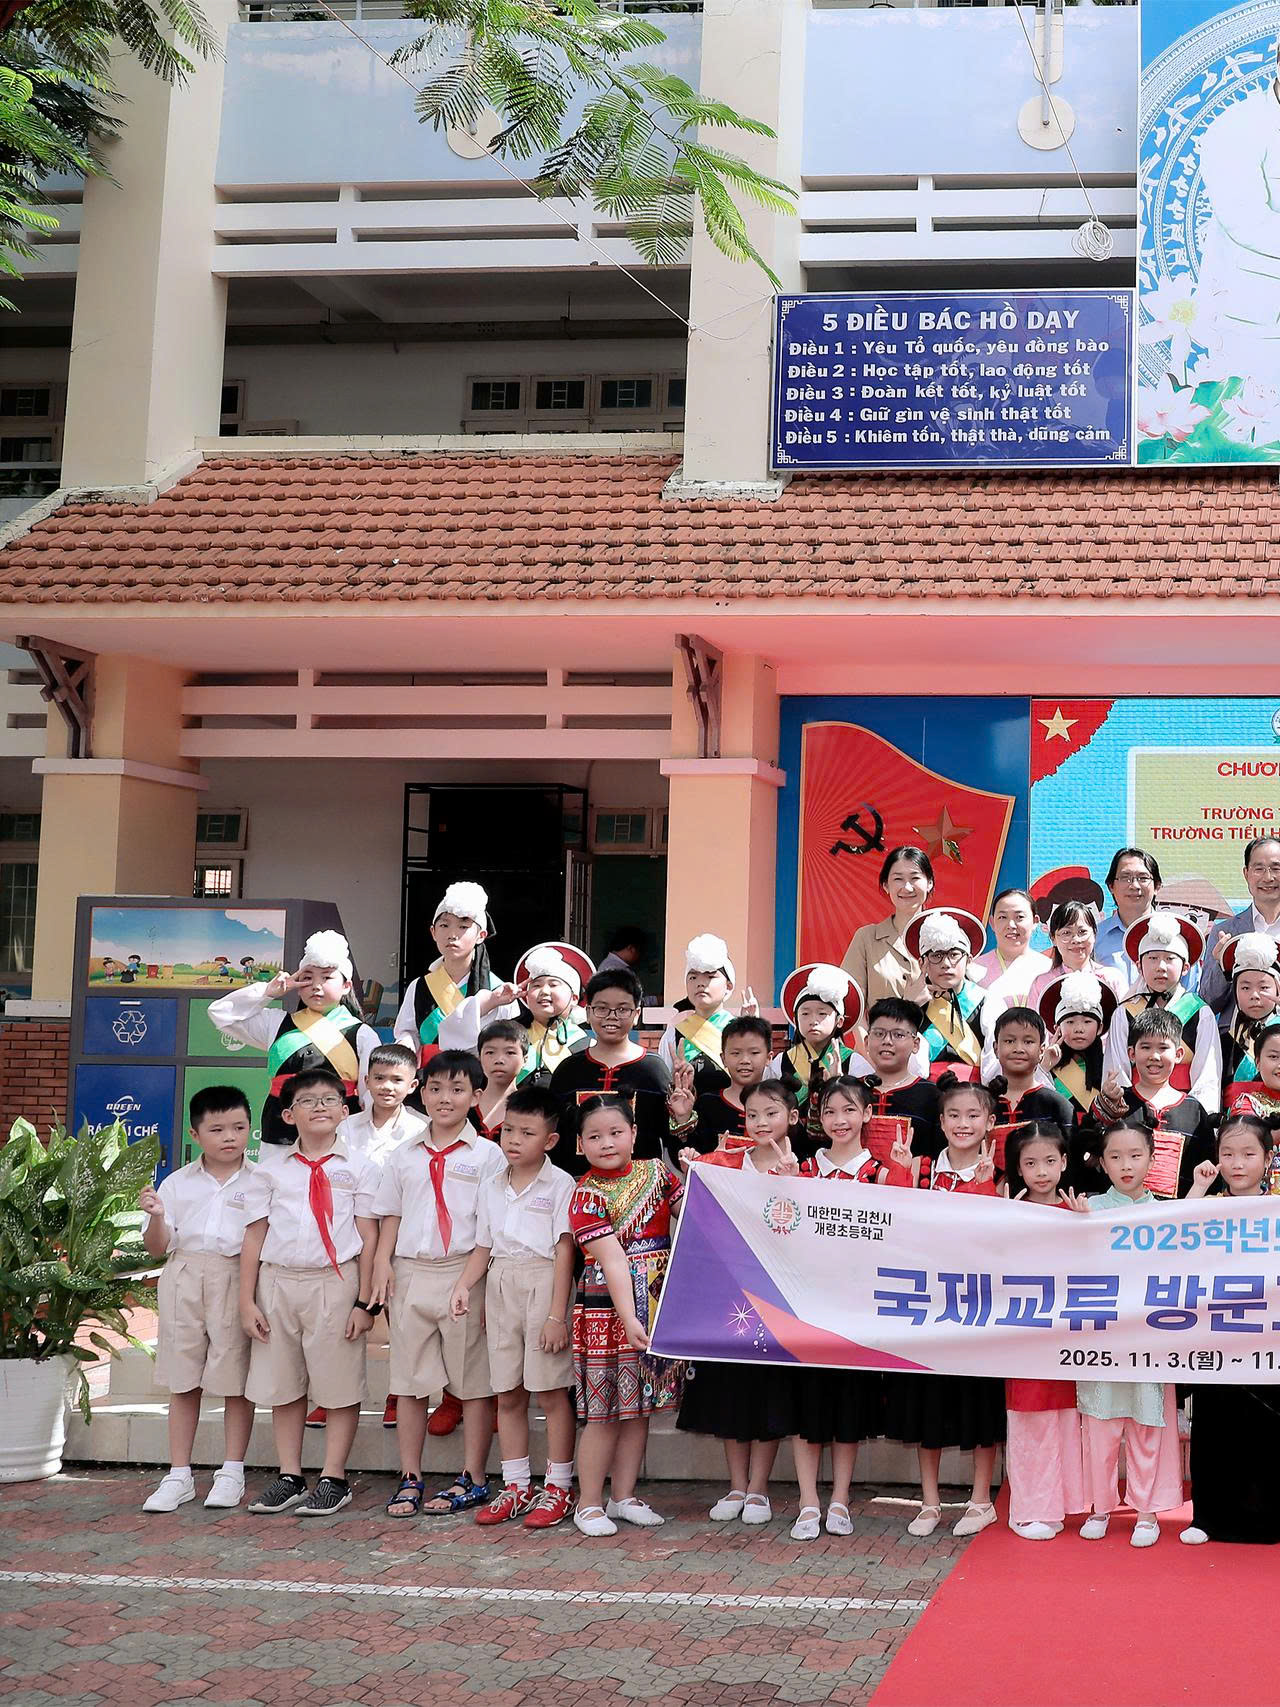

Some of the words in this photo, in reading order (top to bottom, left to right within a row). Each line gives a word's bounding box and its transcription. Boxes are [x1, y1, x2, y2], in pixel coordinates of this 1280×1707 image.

[822, 313, 838, 331] 5
[846, 304, 908, 331] ĐIỀU
[918, 307, 971, 330] BÁC
[980, 302, 1018, 330] HỒ
[1027, 310, 1080, 334] DẠY
[789, 340, 829, 356] Điều
[834, 342, 844, 355] 1
[862, 341, 897, 354] Yêu
[904, 335, 926, 353] Tổ
[932, 337, 981, 356] quốc,
[986, 340, 1019, 355] yêu
[1024, 337, 1069, 353] đồng
[1075, 338, 1110, 352] bào
[788, 362, 828, 379] Điều
[832, 365, 845, 377] 2
[863, 363, 897, 380] Học
[904, 363, 934, 380] tập
[941, 361, 974, 378] tốt,
[980, 363, 1007, 376] lao
[1013, 363, 1057, 379] động
[1063, 359, 1090, 375] tốt
[786, 384, 826, 401] Điều
[832, 387, 844, 400] 3
[861, 384, 907, 398] Đoàn
[915, 381, 944, 398] kết
[951, 382, 984, 400] tốt,
[989, 383, 1011, 400] kỷ
[1017, 384, 1053, 401] luật
[1060, 380, 1087, 397] tốt
[784, 405, 825, 422] Điều
[829, 409, 842, 421] 4
[860, 406, 891, 421] Giữ
[895, 408, 923, 423] gìn
[929, 407, 951, 425] vệ
[957, 407, 995, 421] sinh
[1000, 406, 1039, 423] thật
[1044, 403, 1072, 419] tốt
[785, 427, 822, 444] Điều
[826, 431, 837, 443] 5
[855, 430, 908, 444] Khiêm
[911, 425, 946, 444] tốn,
[950, 429, 985, 446] thật
[991, 428, 1023, 442] thà,
[1028, 426, 1070, 442] dũng
[1075, 425, 1110, 441] cảm
[1200, 805, 1274, 820] TRƯỜNG
[1150, 825, 1224, 840] TRƯỜNG
[1228, 824, 1265, 840] TIỂU
[807, 1205, 853, 1222] 대한민국
[857, 1210, 892, 1226] 김천시
[814, 1221, 884, 1241] 개령초등학교
[874, 1266, 1119, 1332] 국제교류
[1059, 1349, 1119, 1367] 2025.
[1128, 1352, 1159, 1367] 11.
[1167, 1350, 1223, 1371] 3.(월)
